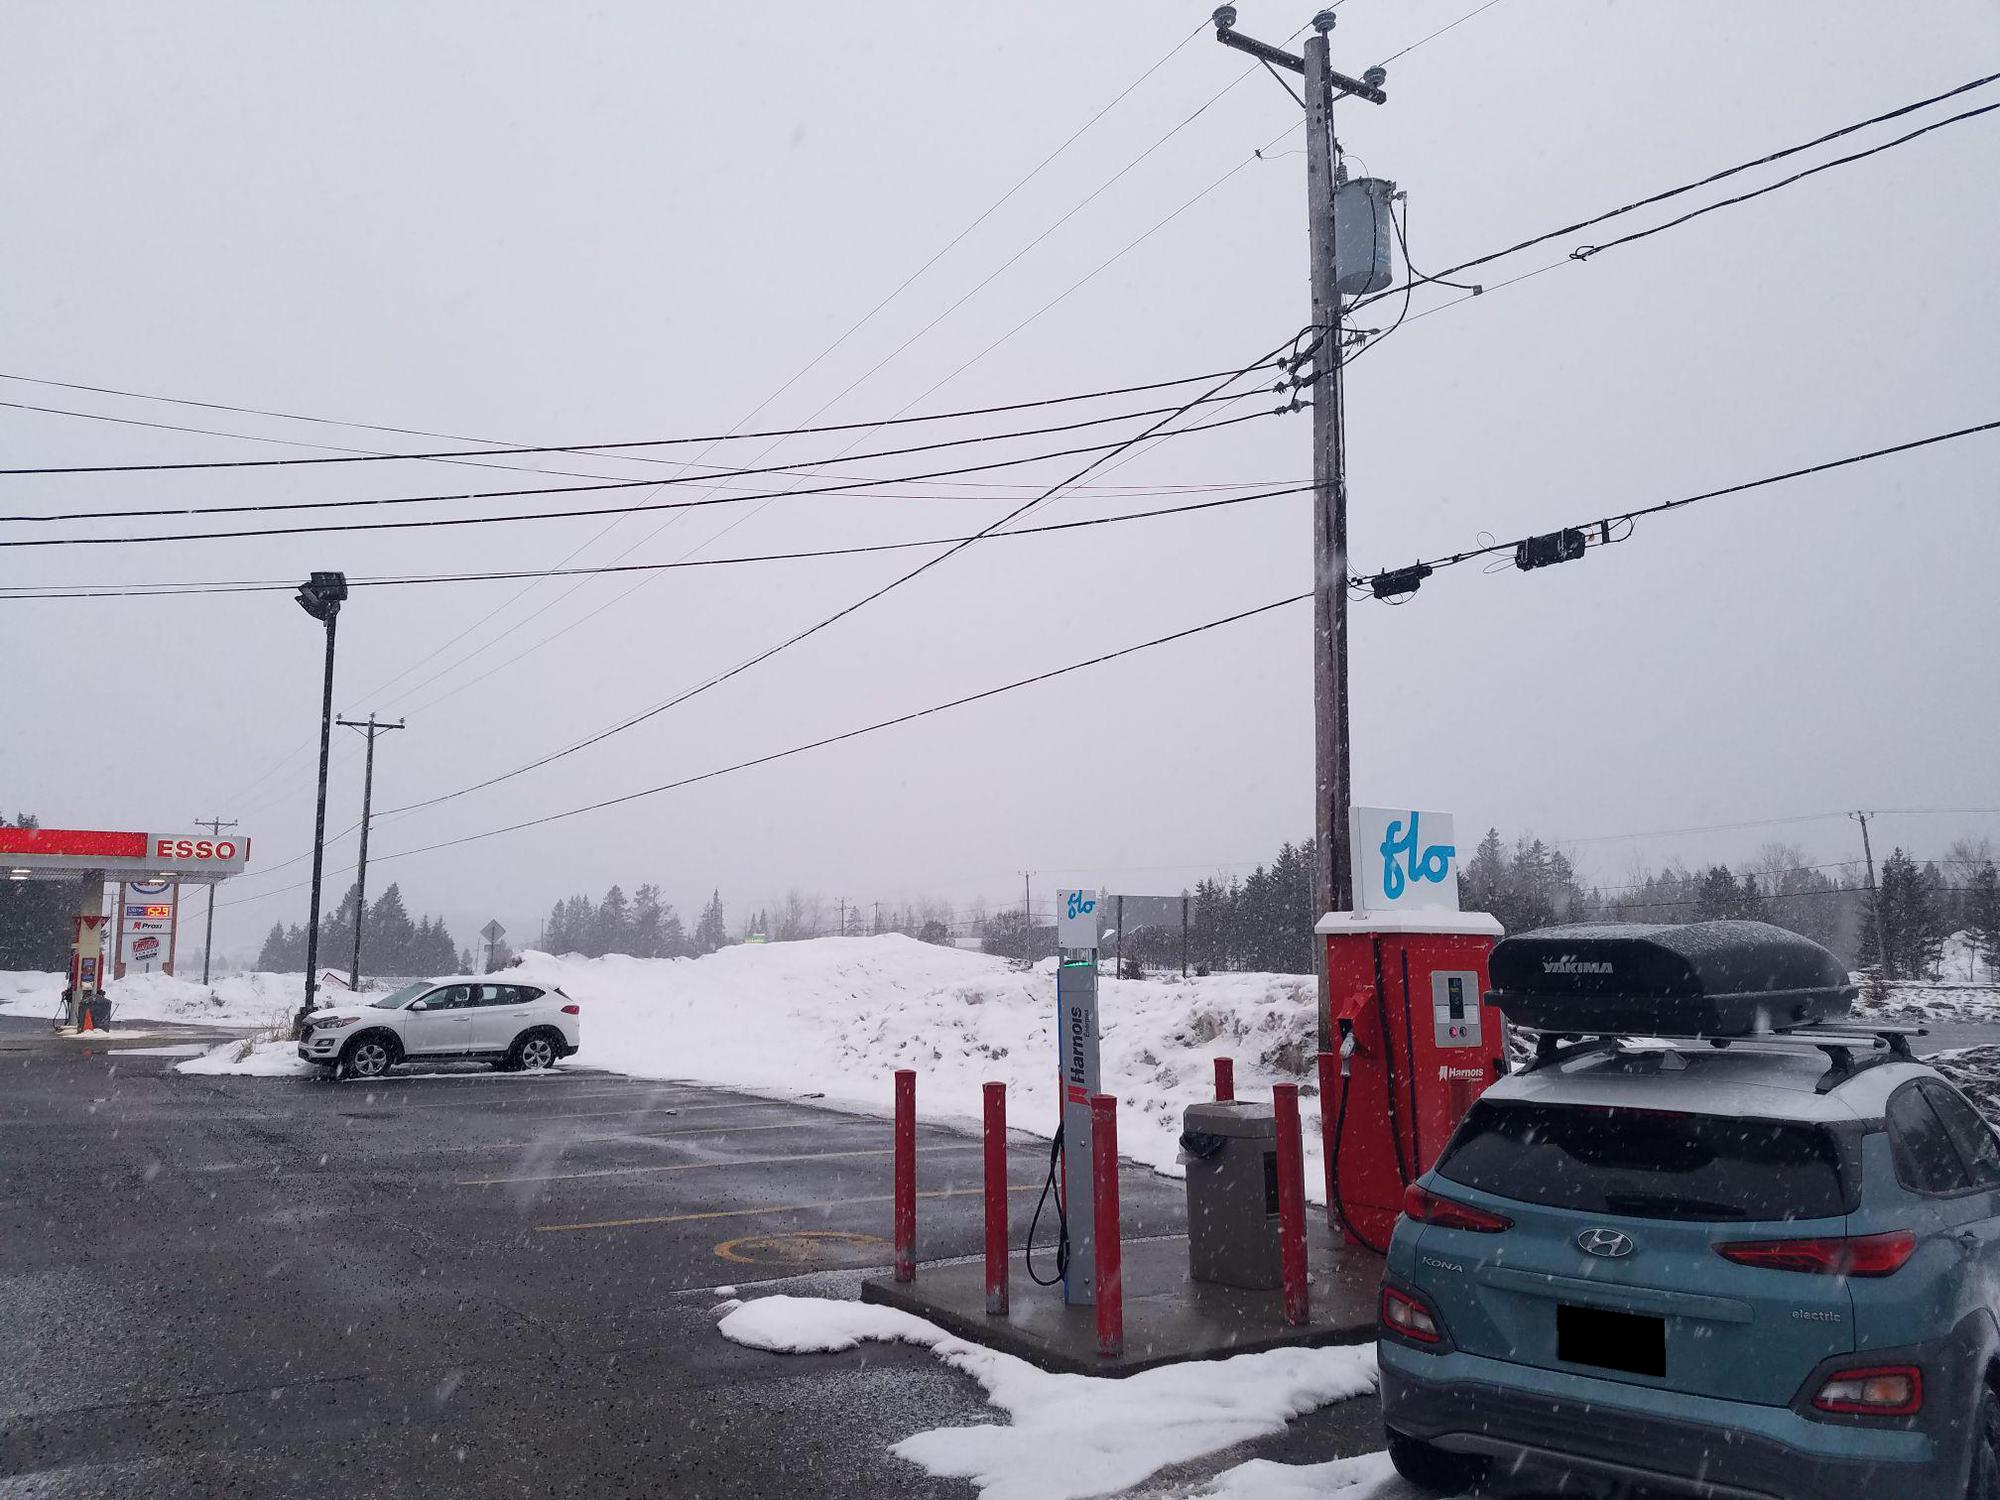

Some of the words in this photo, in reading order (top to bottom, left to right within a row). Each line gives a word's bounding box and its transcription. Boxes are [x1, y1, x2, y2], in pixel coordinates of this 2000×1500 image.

[157, 839, 236, 859] ESSO
[1380, 811, 1456, 899] flo
[1067, 889, 1096, 919] flo
[1542, 962, 1613, 973] YAKIMA
[1071, 1006, 1085, 1084] Harnois
[1448, 1067, 1484, 1078] Harnois
[1421, 1256, 1463, 1272] KONA
[1792, 1309, 1841, 1321] electric
